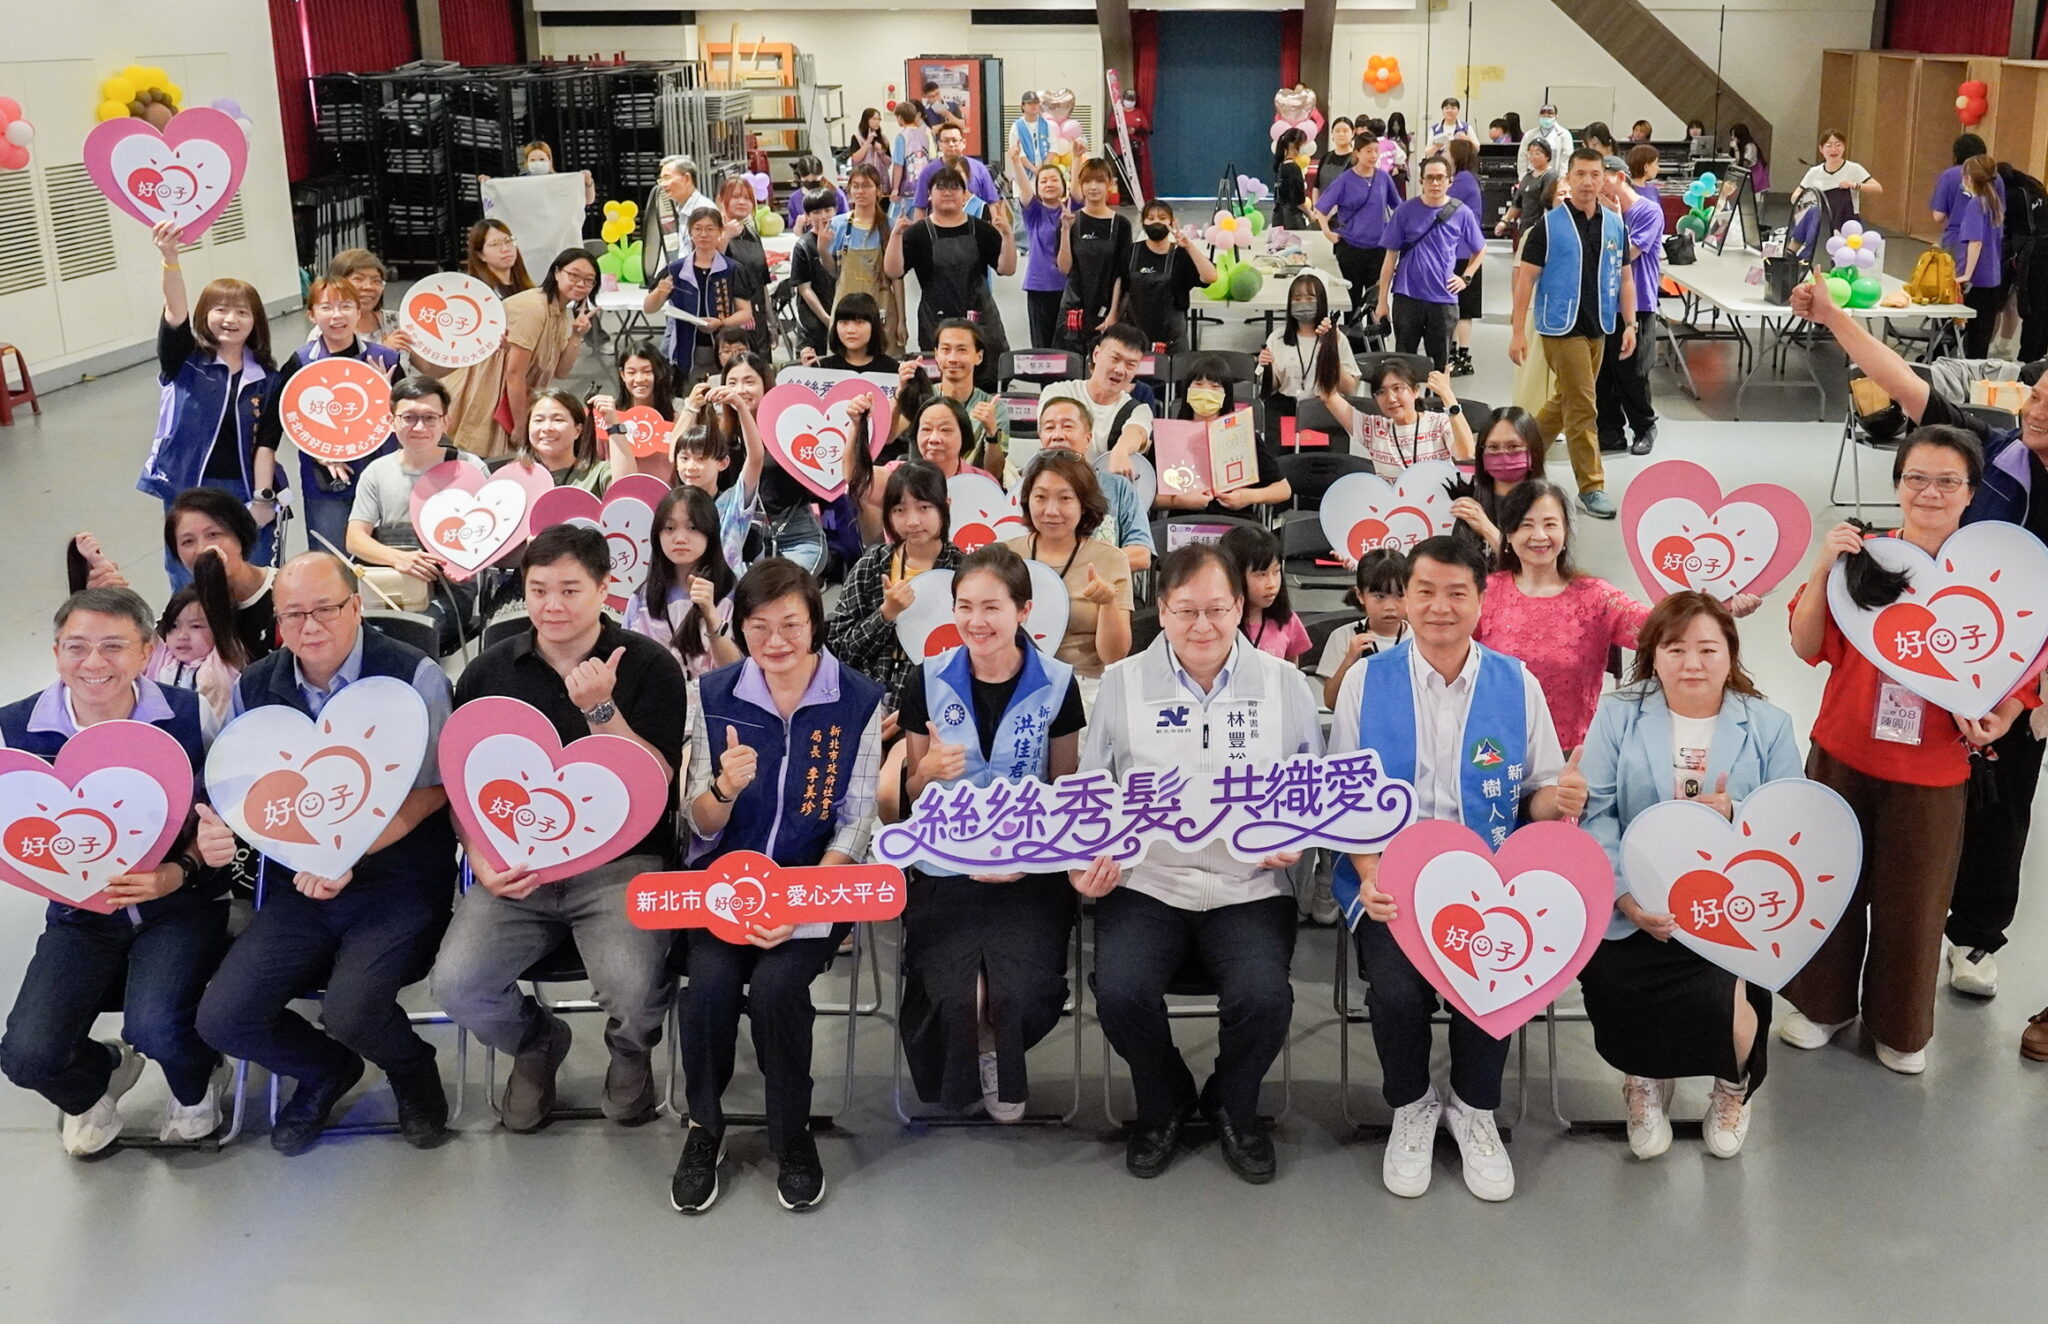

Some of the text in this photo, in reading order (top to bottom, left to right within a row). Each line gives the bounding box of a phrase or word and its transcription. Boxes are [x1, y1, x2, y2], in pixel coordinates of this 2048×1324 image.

[800, 729, 822, 817] 局長 李美珍
[819, 725, 841, 820] 新北市政府社會局
[1008, 714, 1036, 778] 洪佳君
[1482, 778, 1507, 846] 樹人家
[637, 890, 701, 912] 新北市
[787, 881, 896, 907] 愛心大平台
